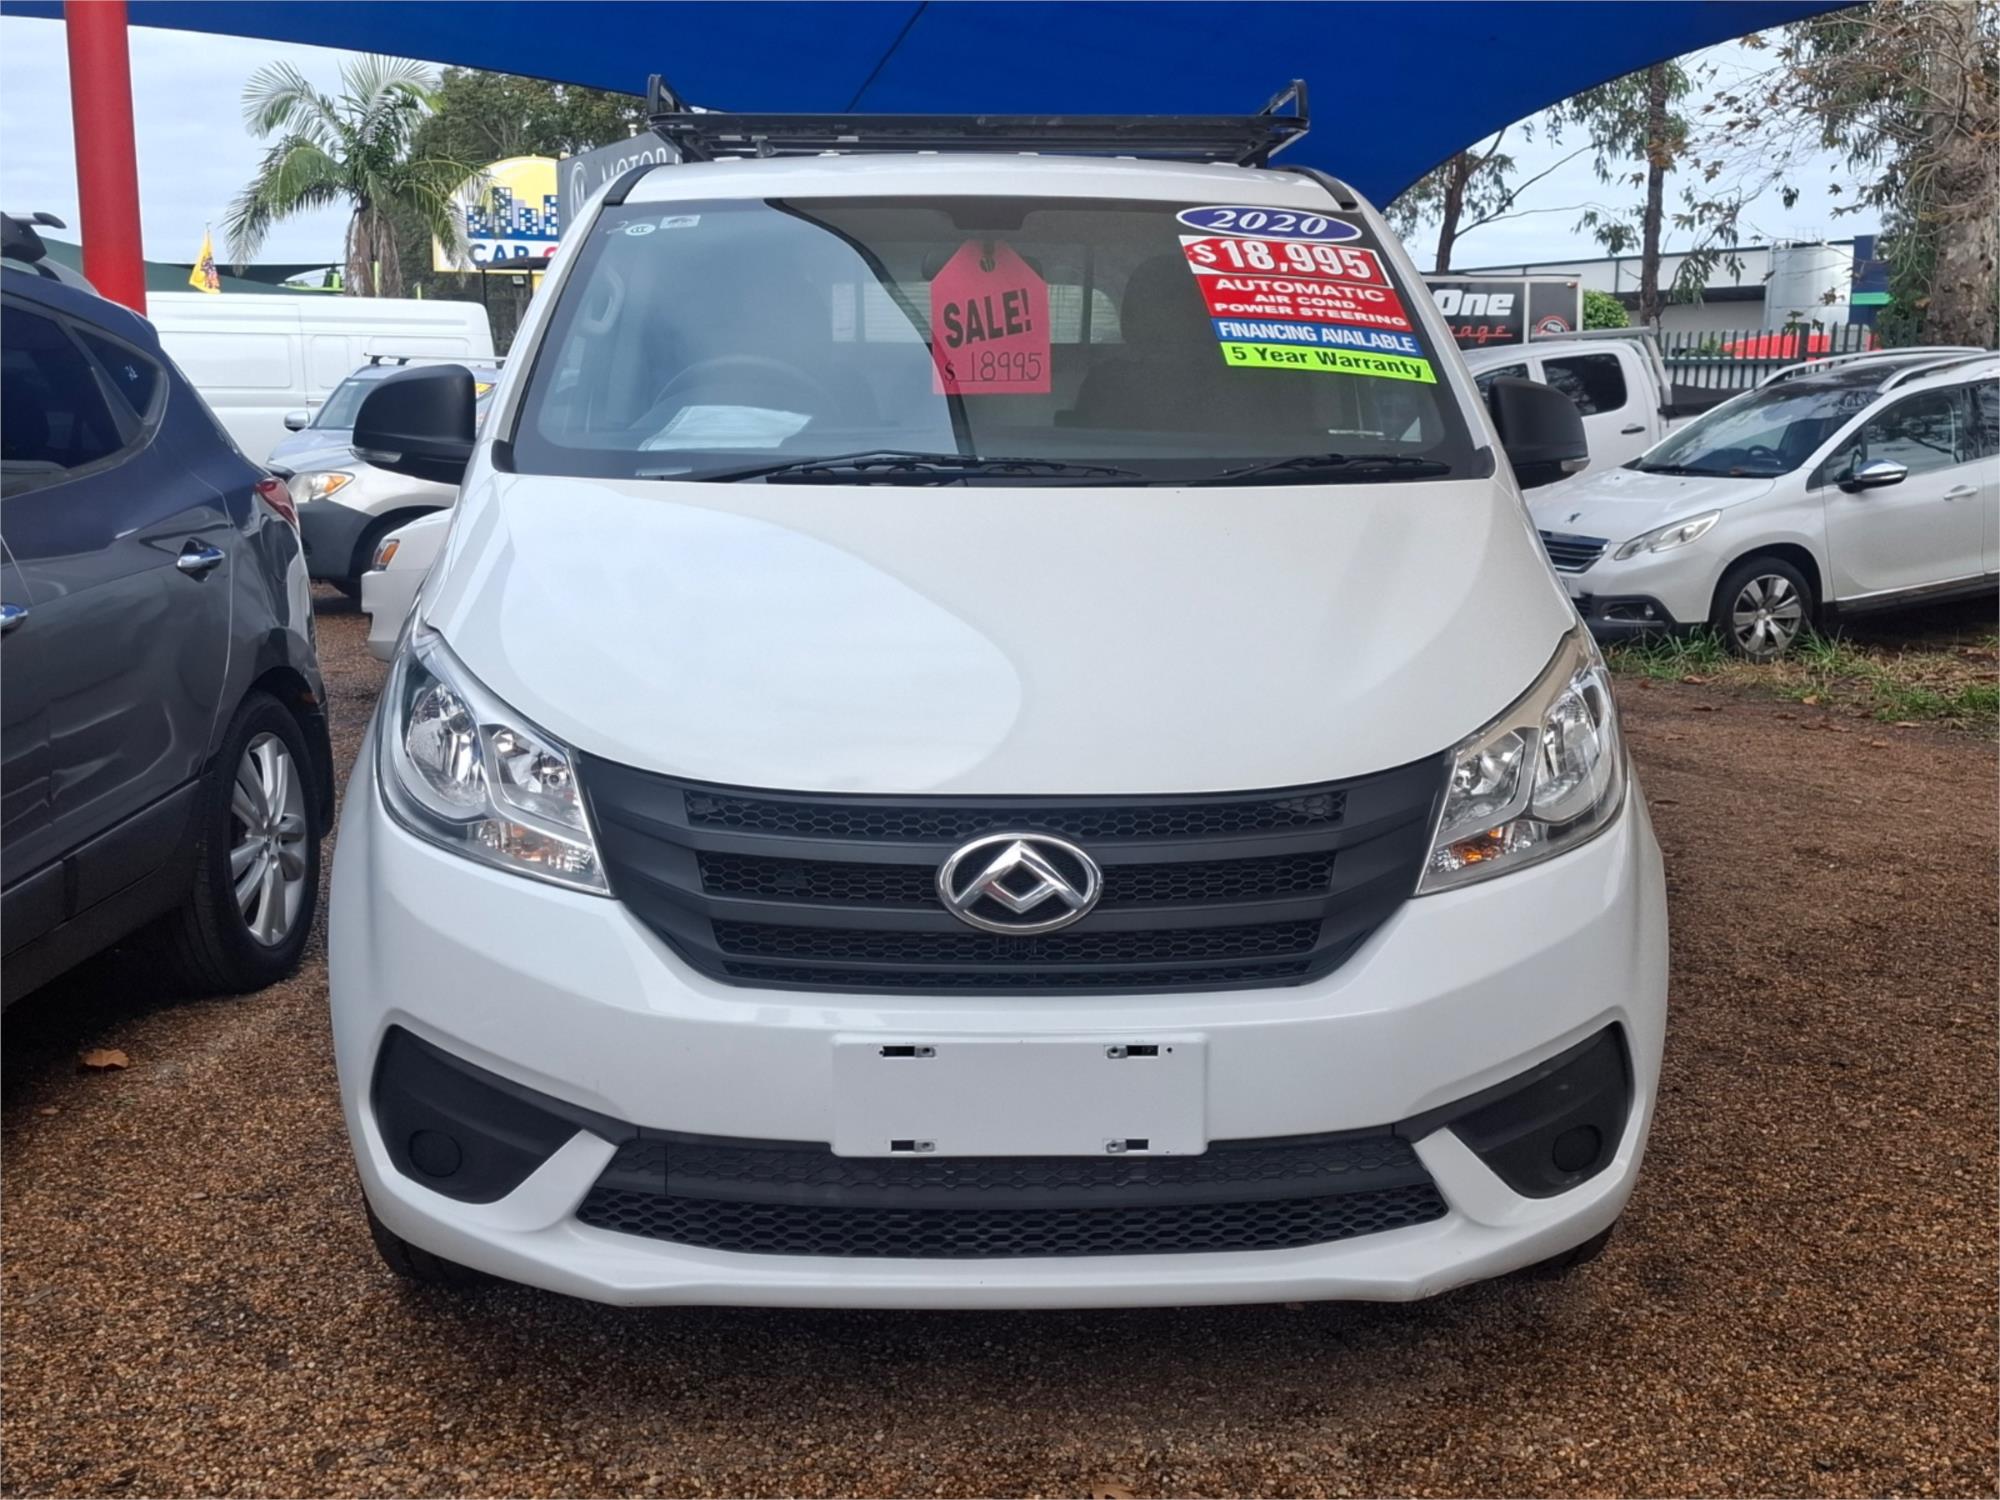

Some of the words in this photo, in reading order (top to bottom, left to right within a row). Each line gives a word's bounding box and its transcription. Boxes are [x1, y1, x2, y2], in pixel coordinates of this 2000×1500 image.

[1207, 210, 1329, 235] 2020
[1192, 239, 1372, 279] $18,995
[1216, 278, 1386, 302] AUTOMATIC
[1254, 293, 1291, 304] AIR
[1296, 296, 1363, 311] COND.
[1433, 289, 1516, 316] One
[943, 288, 1032, 349] SALE!
[1214, 302, 1293, 316] POWER
[1297, 307, 1408, 327] STEERING
[1218, 321, 1317, 341] FINANCING
[1322, 328, 1417, 353] AVAILABLE
[944, 360, 956, 385] $
[971, 350, 1042, 382] 18995
[1231, 346, 1247, 361] 5
[1255, 347, 1308, 364] Year
[1317, 351, 1423, 379] Warranty
